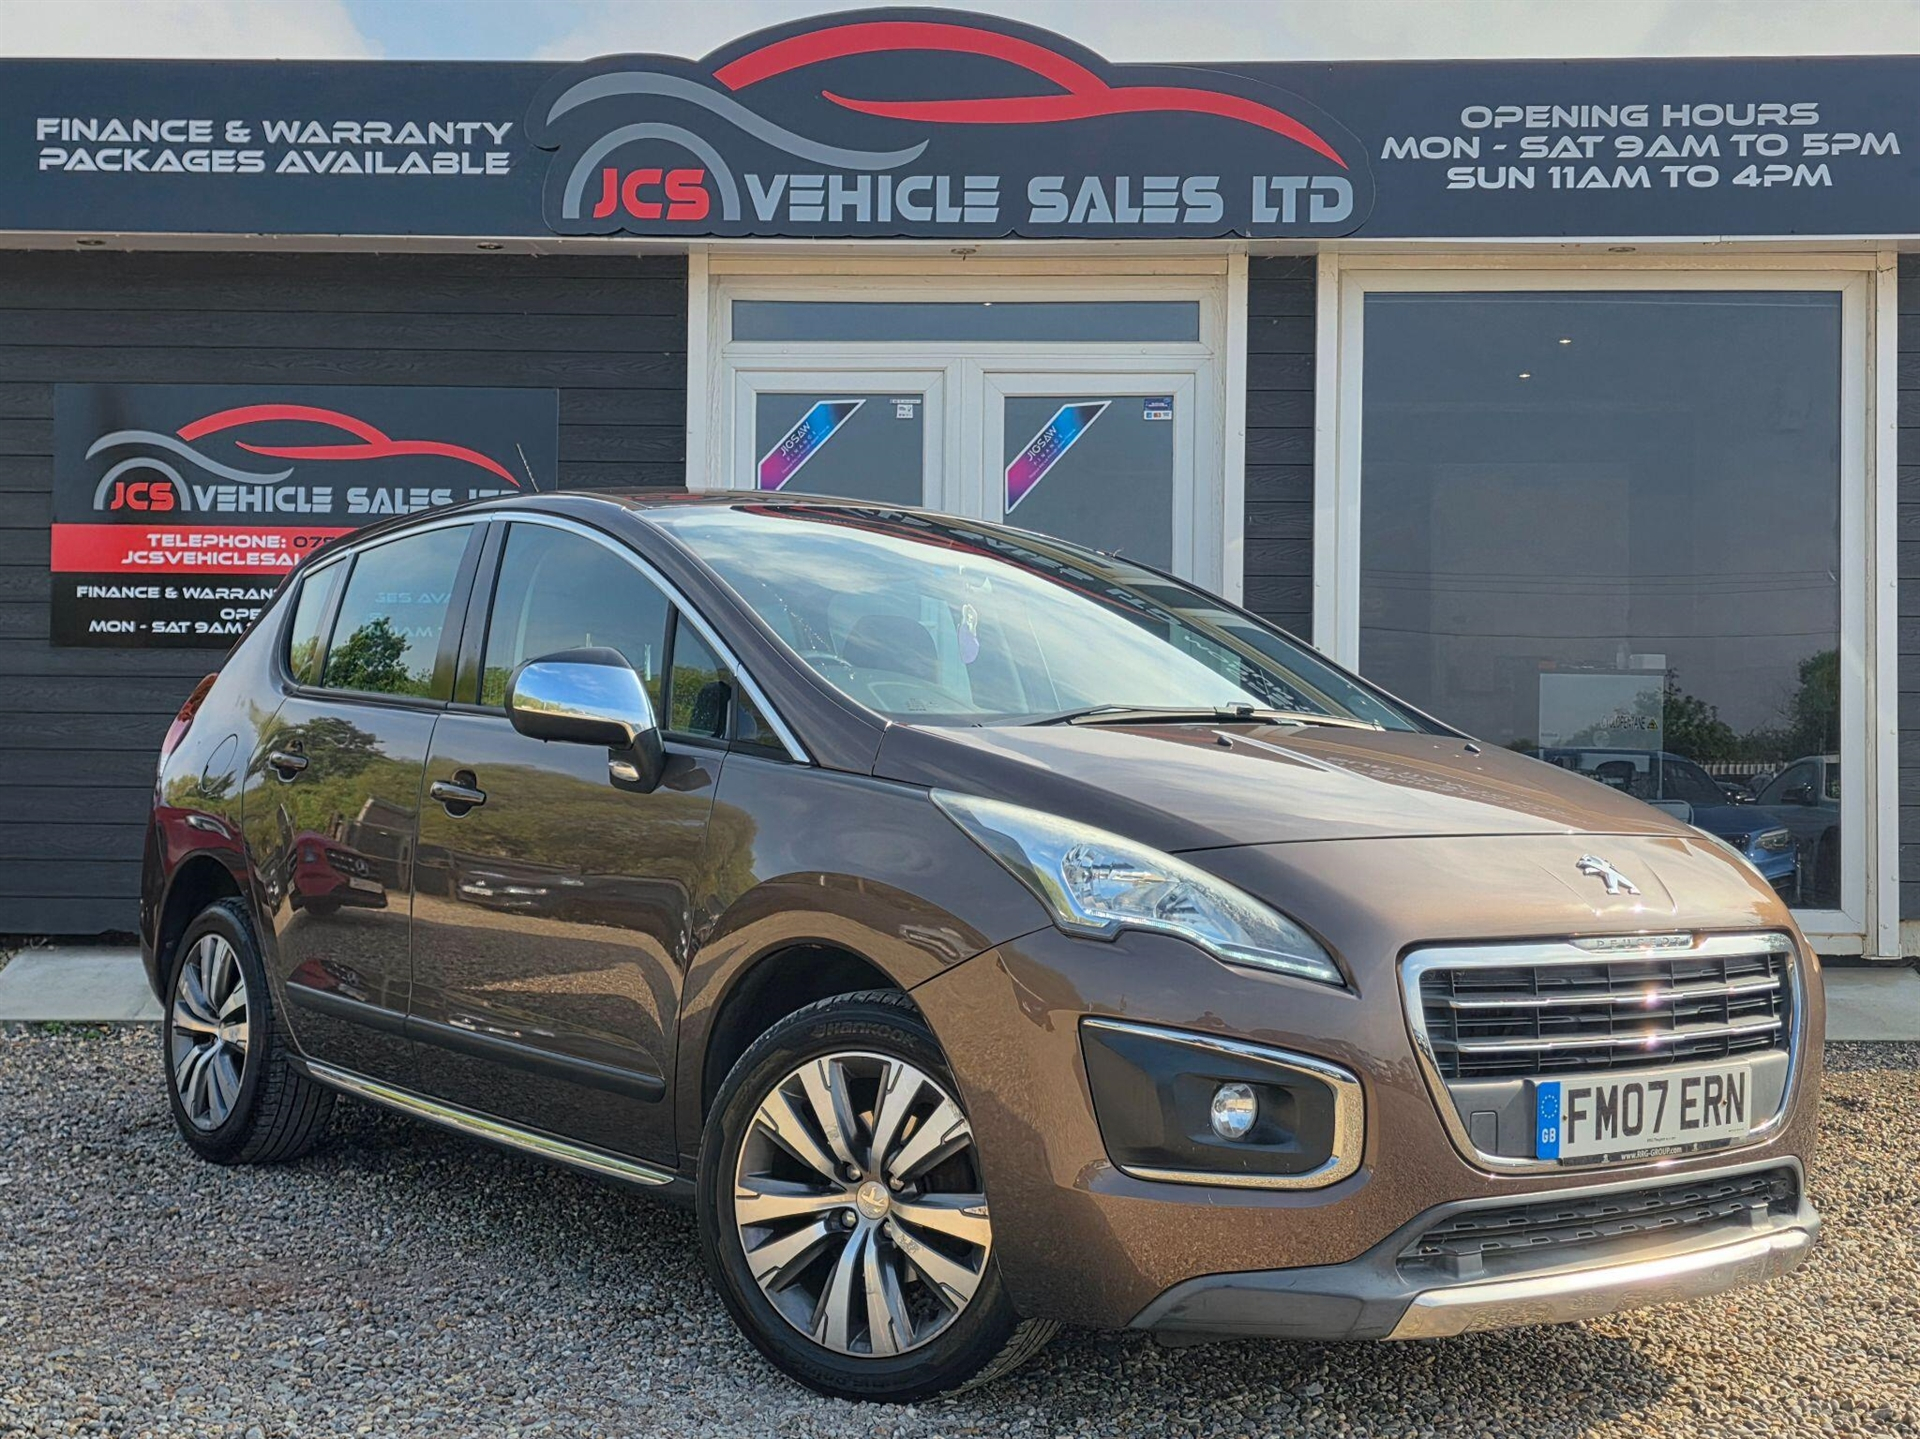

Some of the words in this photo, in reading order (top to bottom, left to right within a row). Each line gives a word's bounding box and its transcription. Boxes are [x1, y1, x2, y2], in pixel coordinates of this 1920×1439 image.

[1461, 105, 1648, 128] OPENING
[1663, 103, 1819, 126] HOURS
[37, 118, 213, 142] FINANCE
[225, 121, 250, 142] &
[263, 121, 512, 144] WARRANTY
[1381, 137, 1479, 159] MON
[1520, 136, 1604, 158] SAT
[1615, 135, 1720, 157] 9AM
[1730, 134, 1788, 156] TO
[1803, 133, 1900, 155] 5PM
[40, 148, 265, 172] PACKAGES
[276, 151, 510, 174] AVAILABLE
[1448, 167, 1534, 188] SUN
[1549, 166, 1651, 188] 11AM
[1661, 165, 1719, 187] TO
[1733, 164, 1832, 186] 4PM
[594, 168, 705, 222] JCS
[745, 175, 999, 223] VEHICLE
[1027, 174, 1221, 224] SALES
[1252, 175, 1354, 224] LTD
[780, 421, 811, 457] JIGSAW
[1026, 425, 1057, 461] JIGSAW
[111, 482, 175, 511] JCS
[193, 486, 332, 513] VEHICLE
[346, 487, 453, 514] SALES
[147, 533, 287, 548] TELEPHONE:
[76, 585, 161, 598] FINANCE
[164, 587, 178, 598] &
[182, 587, 277, 600] WARRAN
[89, 620, 136, 633] MON
[152, 621, 192, 633] SAT
[195, 621, 243, 634] 9AM
[1567, 1080, 1669, 1144] FM07
[1680, 1072, 1744, 1130] ERN
[1541, 1127, 1556, 1144] GB
